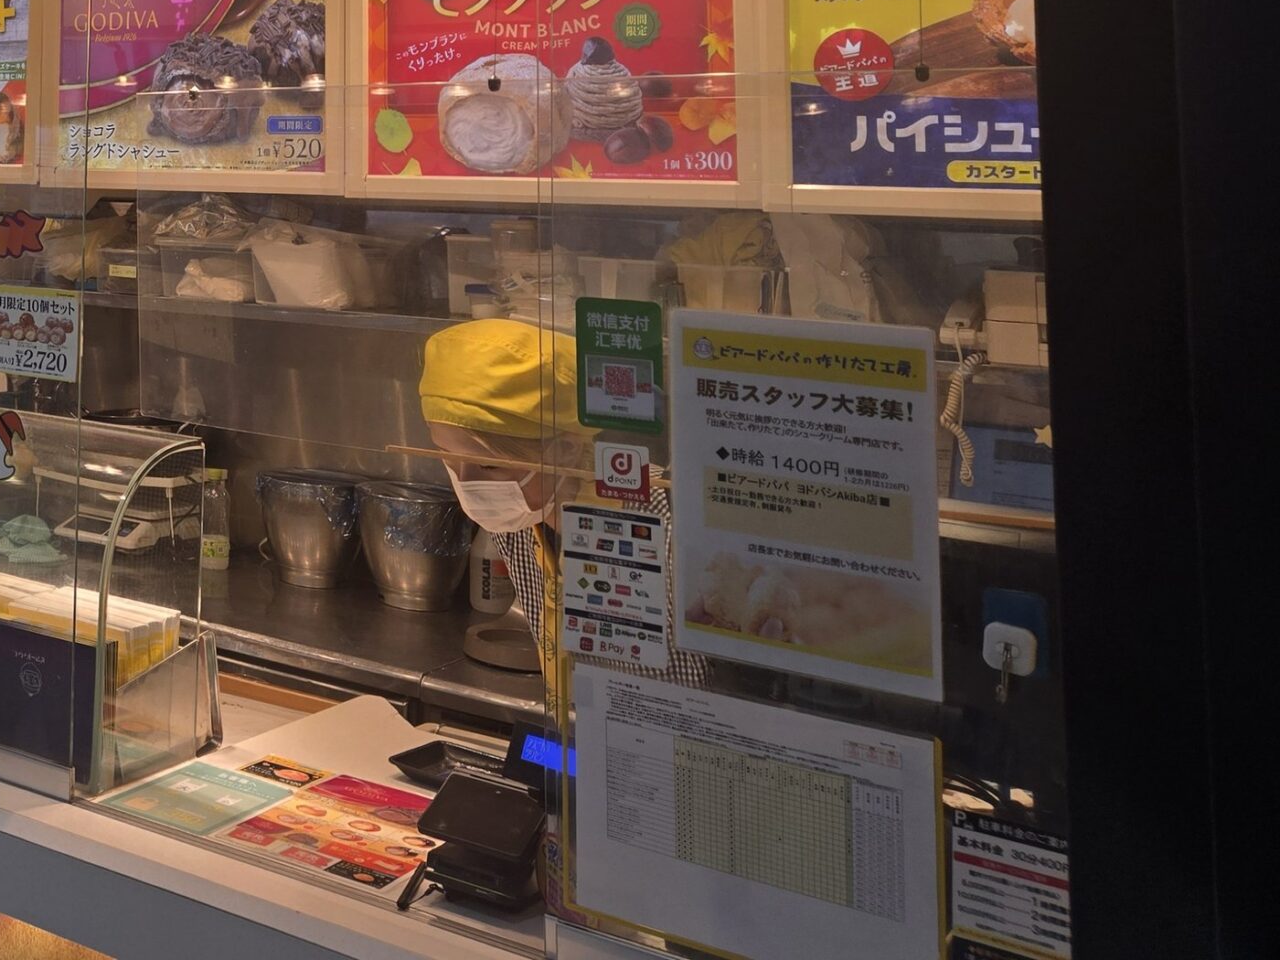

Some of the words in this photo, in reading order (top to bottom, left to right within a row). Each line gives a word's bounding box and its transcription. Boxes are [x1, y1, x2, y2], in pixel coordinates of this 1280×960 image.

[74, 9, 159, 33] GODIVA
[474, 19, 531, 38] MONT
[537, 14, 601, 37] BLANC
[395, 32, 467, 61] このモンブランに
[501, 39, 540, 51] CREAM
[543, 38, 571, 50] PUFF
[408, 51, 462, 73] くりったけ。
[834, 73, 880, 92] 王道
[70, 123, 116, 139] ショコラ
[277, 120, 313, 131] 期間限定
[850, 110, 1039, 153] パイシュ
[70, 142, 180, 160] ラングドシャシュー
[272, 138, 321, 159] ¥520
[663, 158, 680, 170] 1個
[684, 151, 733, 170] ¥300
[586, 312, 650, 332] 微信支付
[595, 331, 642, 350] 汇率优
[15, 348, 67, 373] ¥2,720
[720, 345, 912, 378] ビアードパパの作りたて工房
[771, 454, 841, 478] 1400円
[482, 558, 491, 600] ECOLAB
[608, 642, 624, 655] Pay
